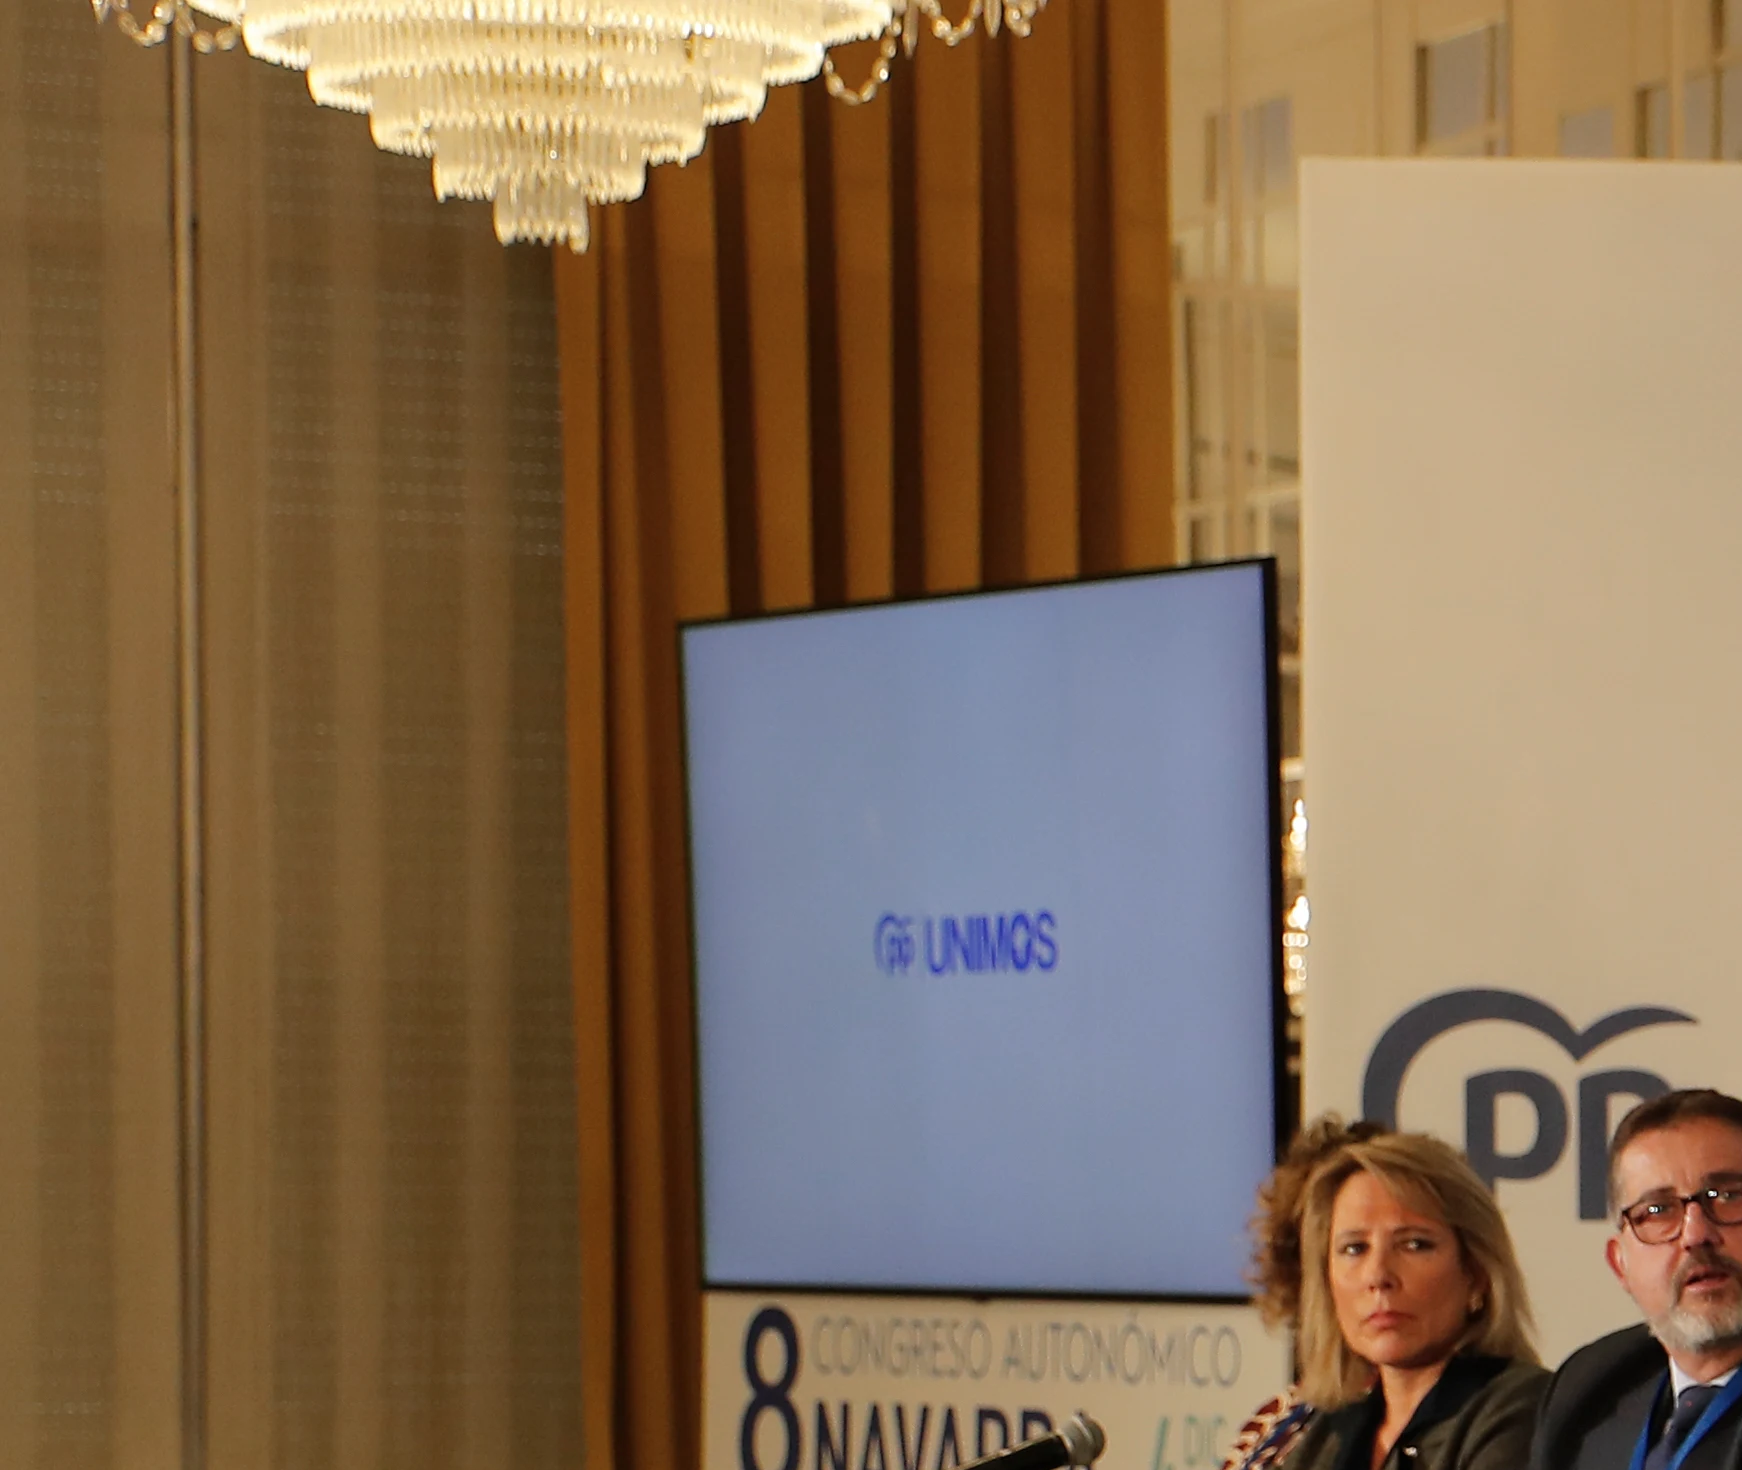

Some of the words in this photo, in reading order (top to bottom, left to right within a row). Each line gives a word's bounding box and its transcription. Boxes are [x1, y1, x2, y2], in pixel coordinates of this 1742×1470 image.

[923, 909, 1059, 977] UNIMOS
[810, 1316, 992, 1381] CONGRESO
[1002, 1310, 1243, 1388] AUTONÓMICO
